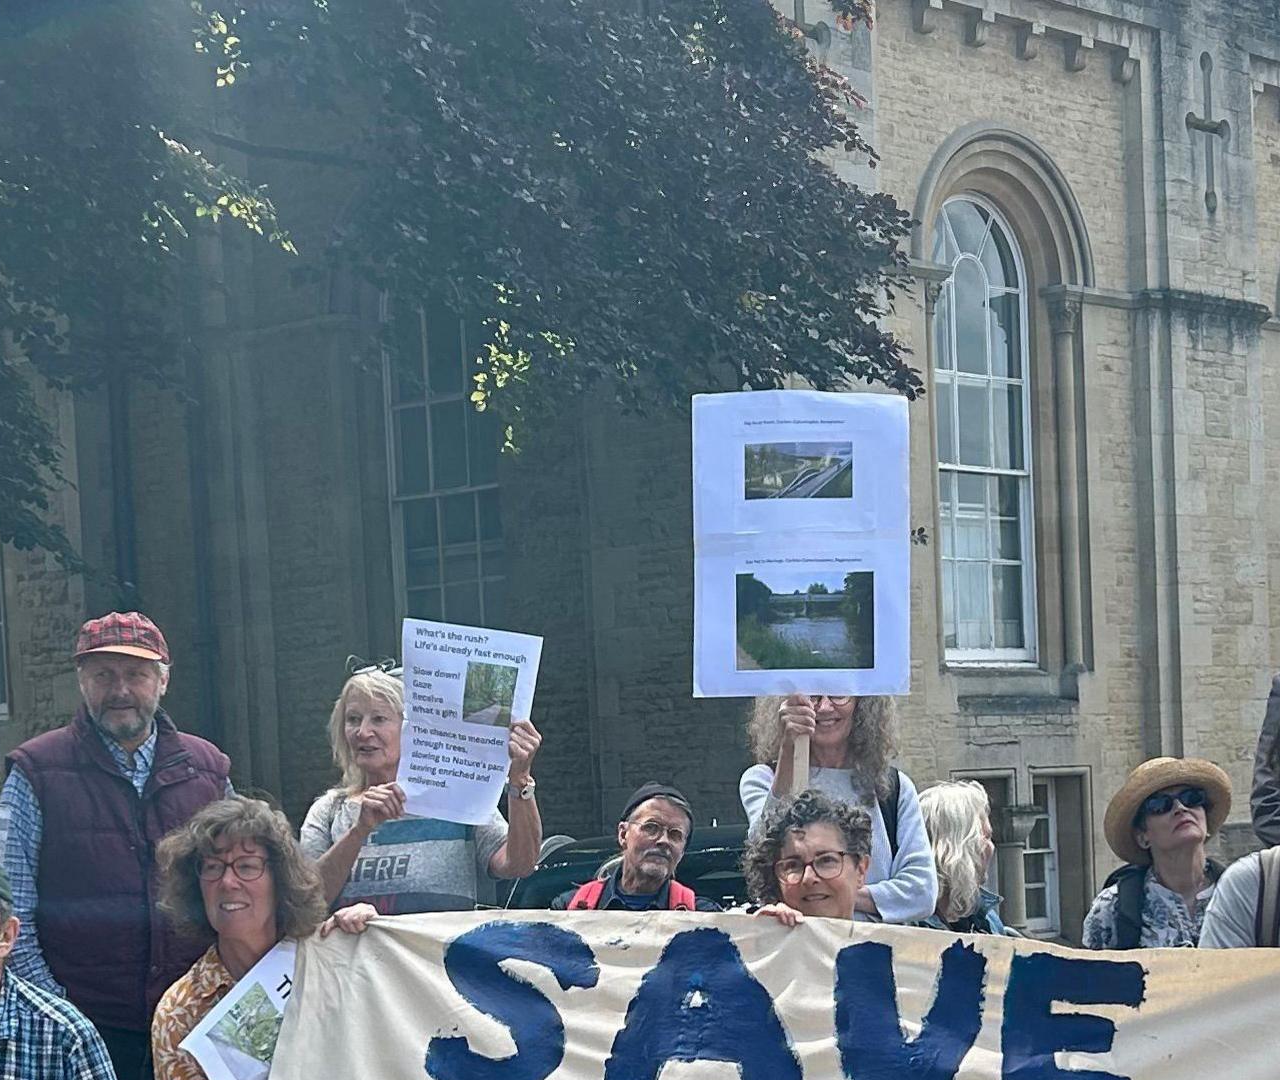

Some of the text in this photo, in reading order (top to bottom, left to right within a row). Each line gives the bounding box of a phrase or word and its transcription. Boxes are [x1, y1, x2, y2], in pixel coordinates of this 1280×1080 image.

[416, 627, 489, 644] What's the rush?
[415, 641, 526, 664] Life's already fast enough
[413, 666, 432, 676] Slow
[413, 726, 428, 734] The
[430, 728, 457, 739] chance
[468, 736, 504, 746] meander
[413, 738, 443, 750] through
[453, 756, 486, 768] Nature's
[439, 767, 475, 779] enriched
